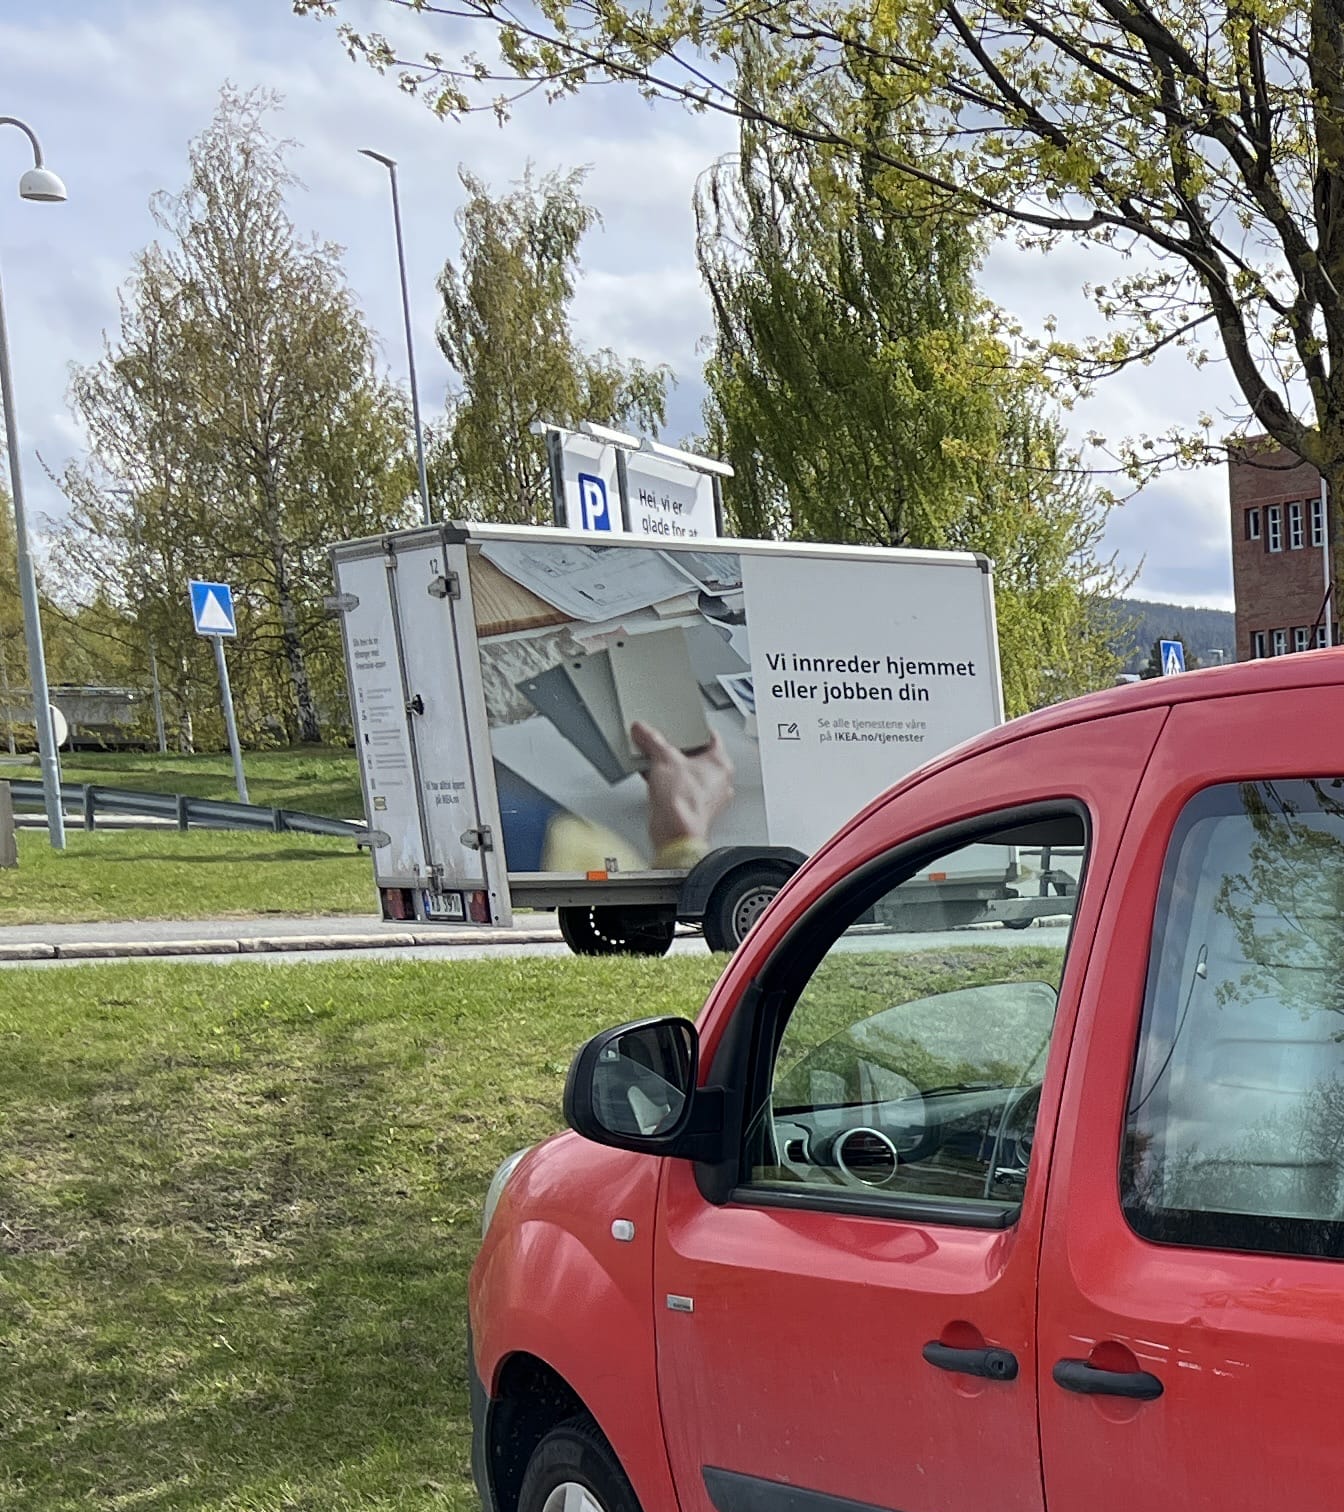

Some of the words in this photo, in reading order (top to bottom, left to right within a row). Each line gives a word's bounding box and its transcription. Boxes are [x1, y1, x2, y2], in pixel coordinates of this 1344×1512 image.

[638, 488, 660, 513] Hei,
[661, 494, 671, 511] vi
[673, 501, 683, 514] er
[642, 515, 670, 536] glade
[429, 558, 439, 575] 12
[765, 653, 786, 671] Vi
[793, 653, 881, 674] innreder
[887, 656, 976, 679] hjemmet
[772, 680, 818, 699] eller
[822, 681, 893, 705] jobben
[899, 683, 929, 701] din
[817, 718, 831, 729] Se
[833, 718, 850, 729] alle
[852, 719, 904, 731] tjenestene
[905, 718, 927, 730] våre
[819, 730, 833, 743] på
[834, 731, 925, 744] IKEA.no/tjenester
